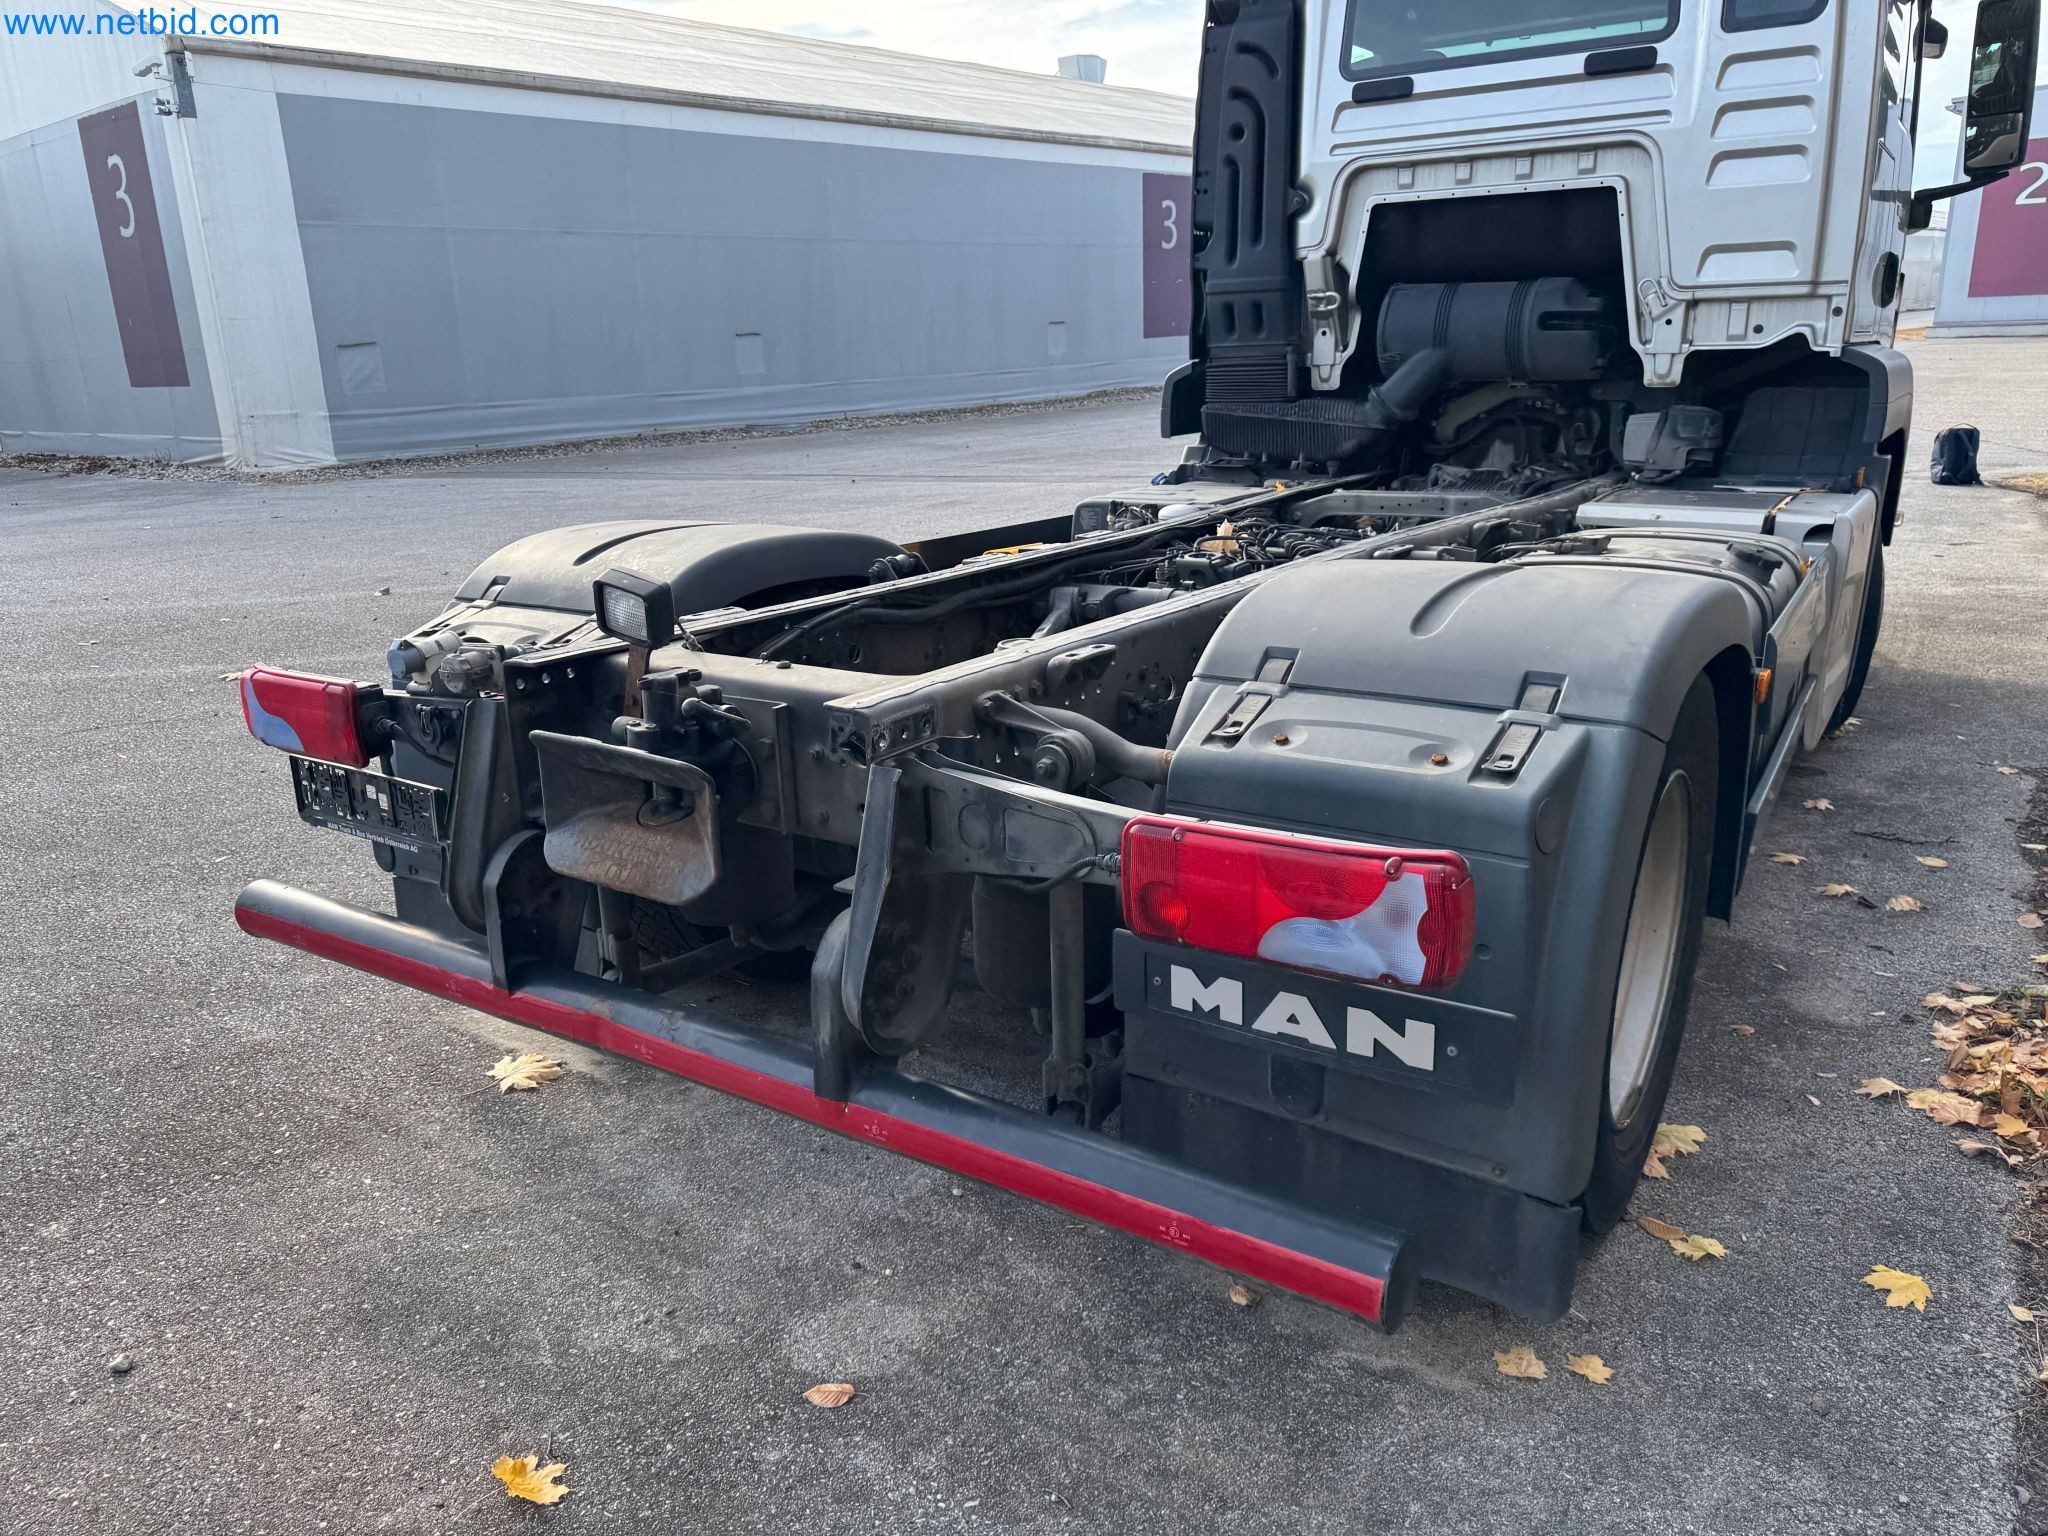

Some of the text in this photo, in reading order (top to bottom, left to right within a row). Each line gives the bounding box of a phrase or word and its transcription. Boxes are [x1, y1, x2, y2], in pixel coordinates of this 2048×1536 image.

[107, 154, 135, 237] 3
[2015, 161, 2048, 205] 2
[1161, 199, 1178, 250] 3
[366, 831, 385, 843] Vertrieb
[410, 844, 419, 853] AG
[1170, 964, 1436, 1071] MAN
